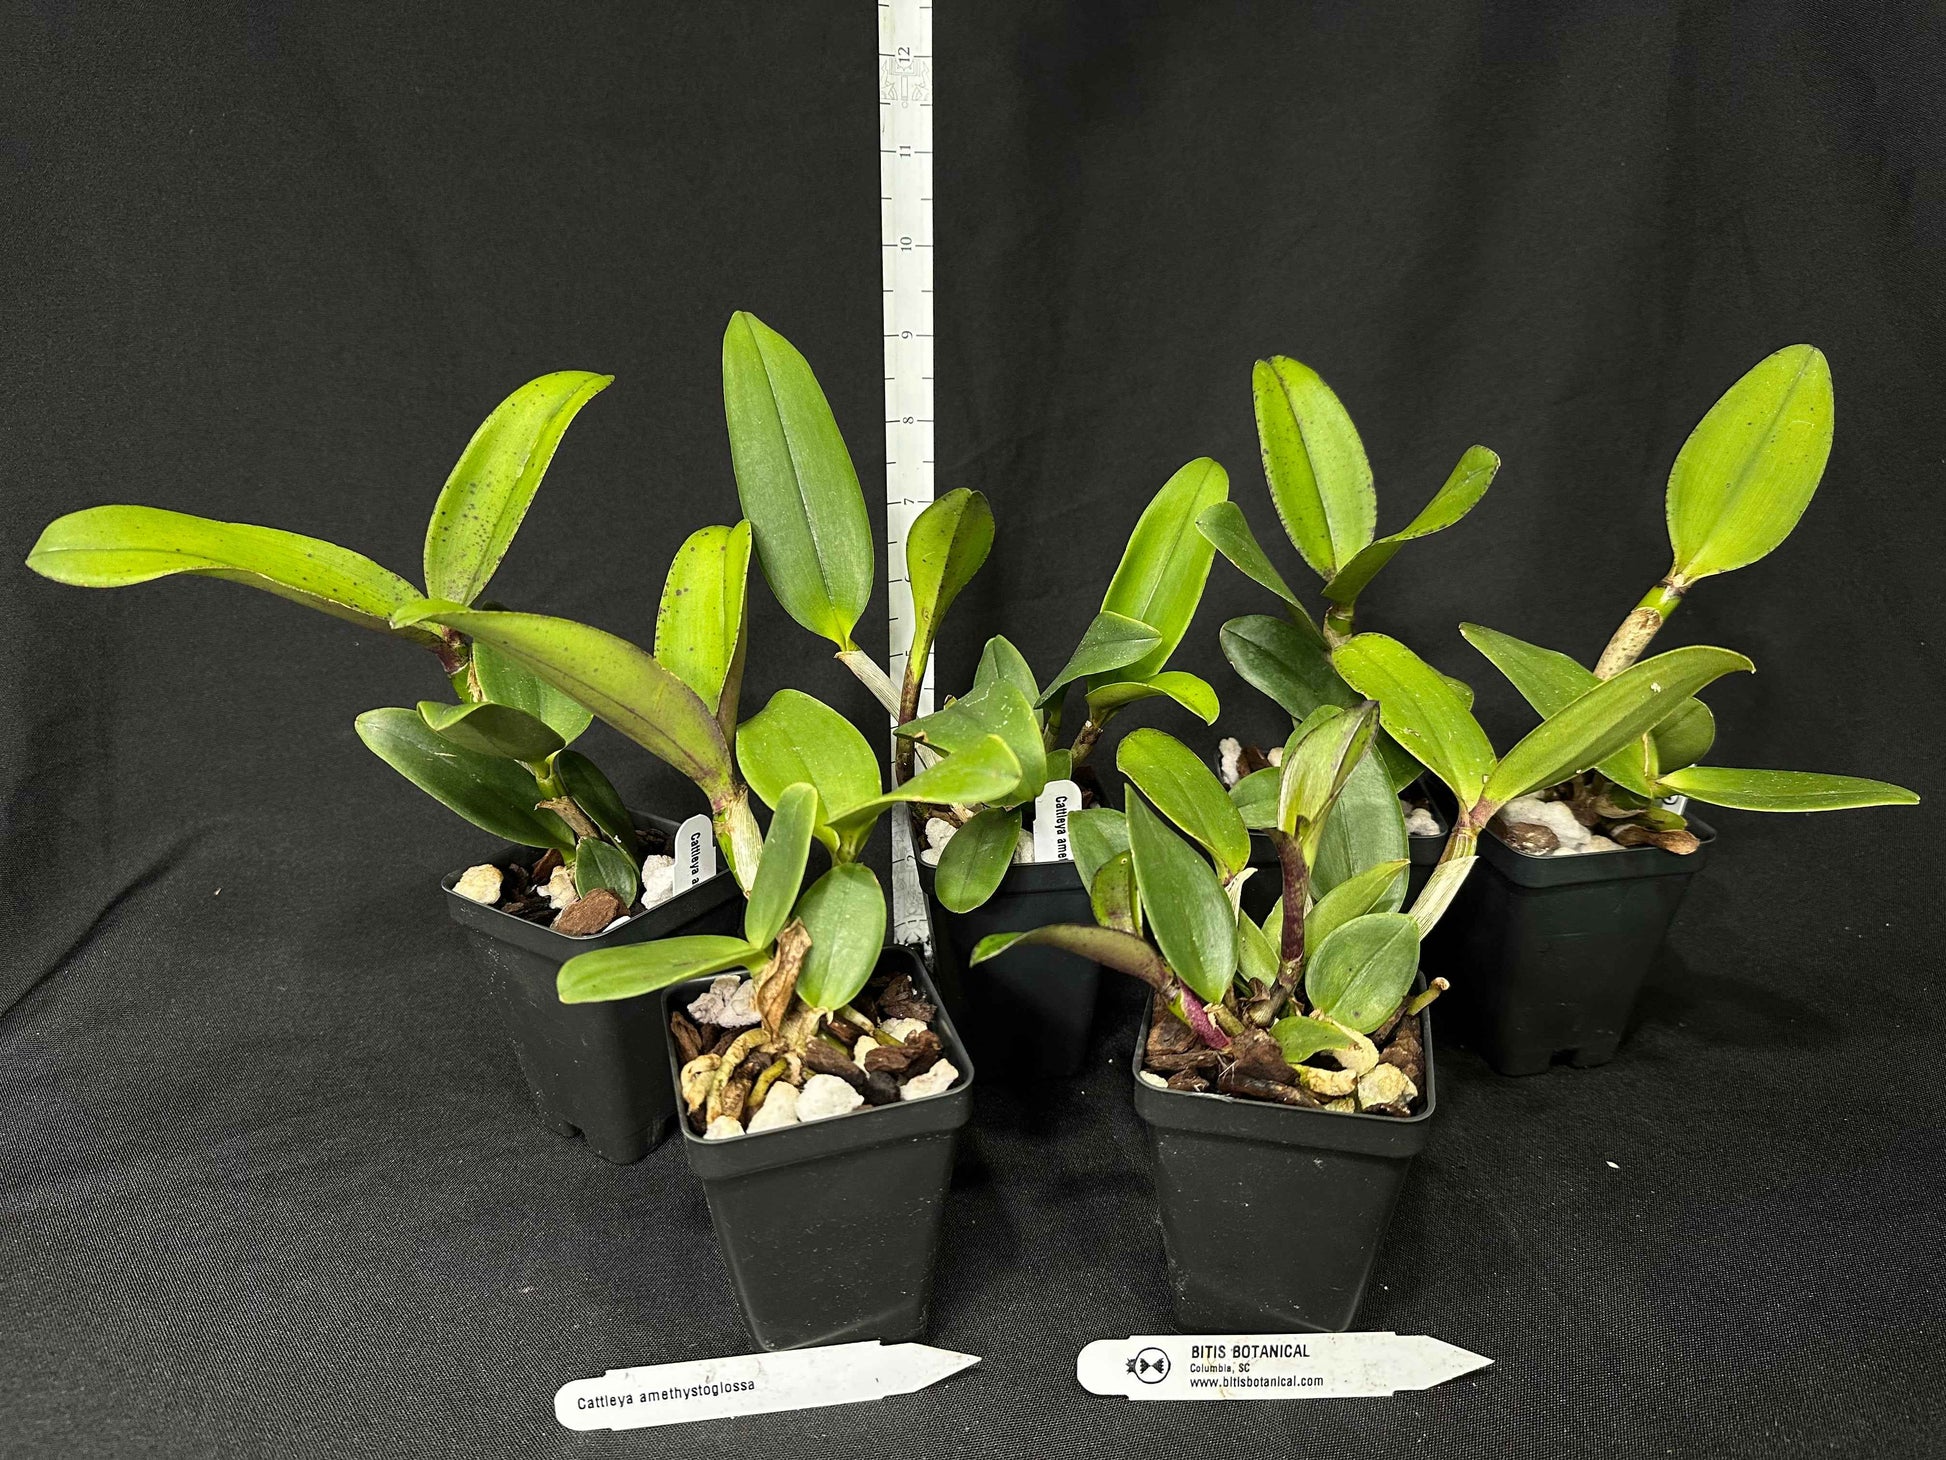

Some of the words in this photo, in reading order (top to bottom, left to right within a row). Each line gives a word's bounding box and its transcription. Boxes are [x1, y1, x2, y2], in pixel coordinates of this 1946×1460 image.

[897, 46, 911, 63] 12
[899, 145, 911, 158] 11
[900, 236, 912, 252] 10
[901, 330, 913, 340] 9
[903, 416, 914, 425] 8
[904, 497, 915, 506] 7
[1054, 796, 1068, 835] Cattleya
[690, 832, 701, 875] Cattleya
[1057, 838, 1068, 861] ame
[1191, 1344, 1227, 1359] BITIS
[1232, 1343, 1311, 1359] BOTANICAL
[1189, 1362, 1236, 1375] Columbia,
[1238, 1362, 1251, 1373] SC
[1189, 1375, 1325, 1388] www.bitisbotanical.com
[577, 1394, 634, 1410] Cattleya
[639, 1379, 756, 1403] amethystoglossa
